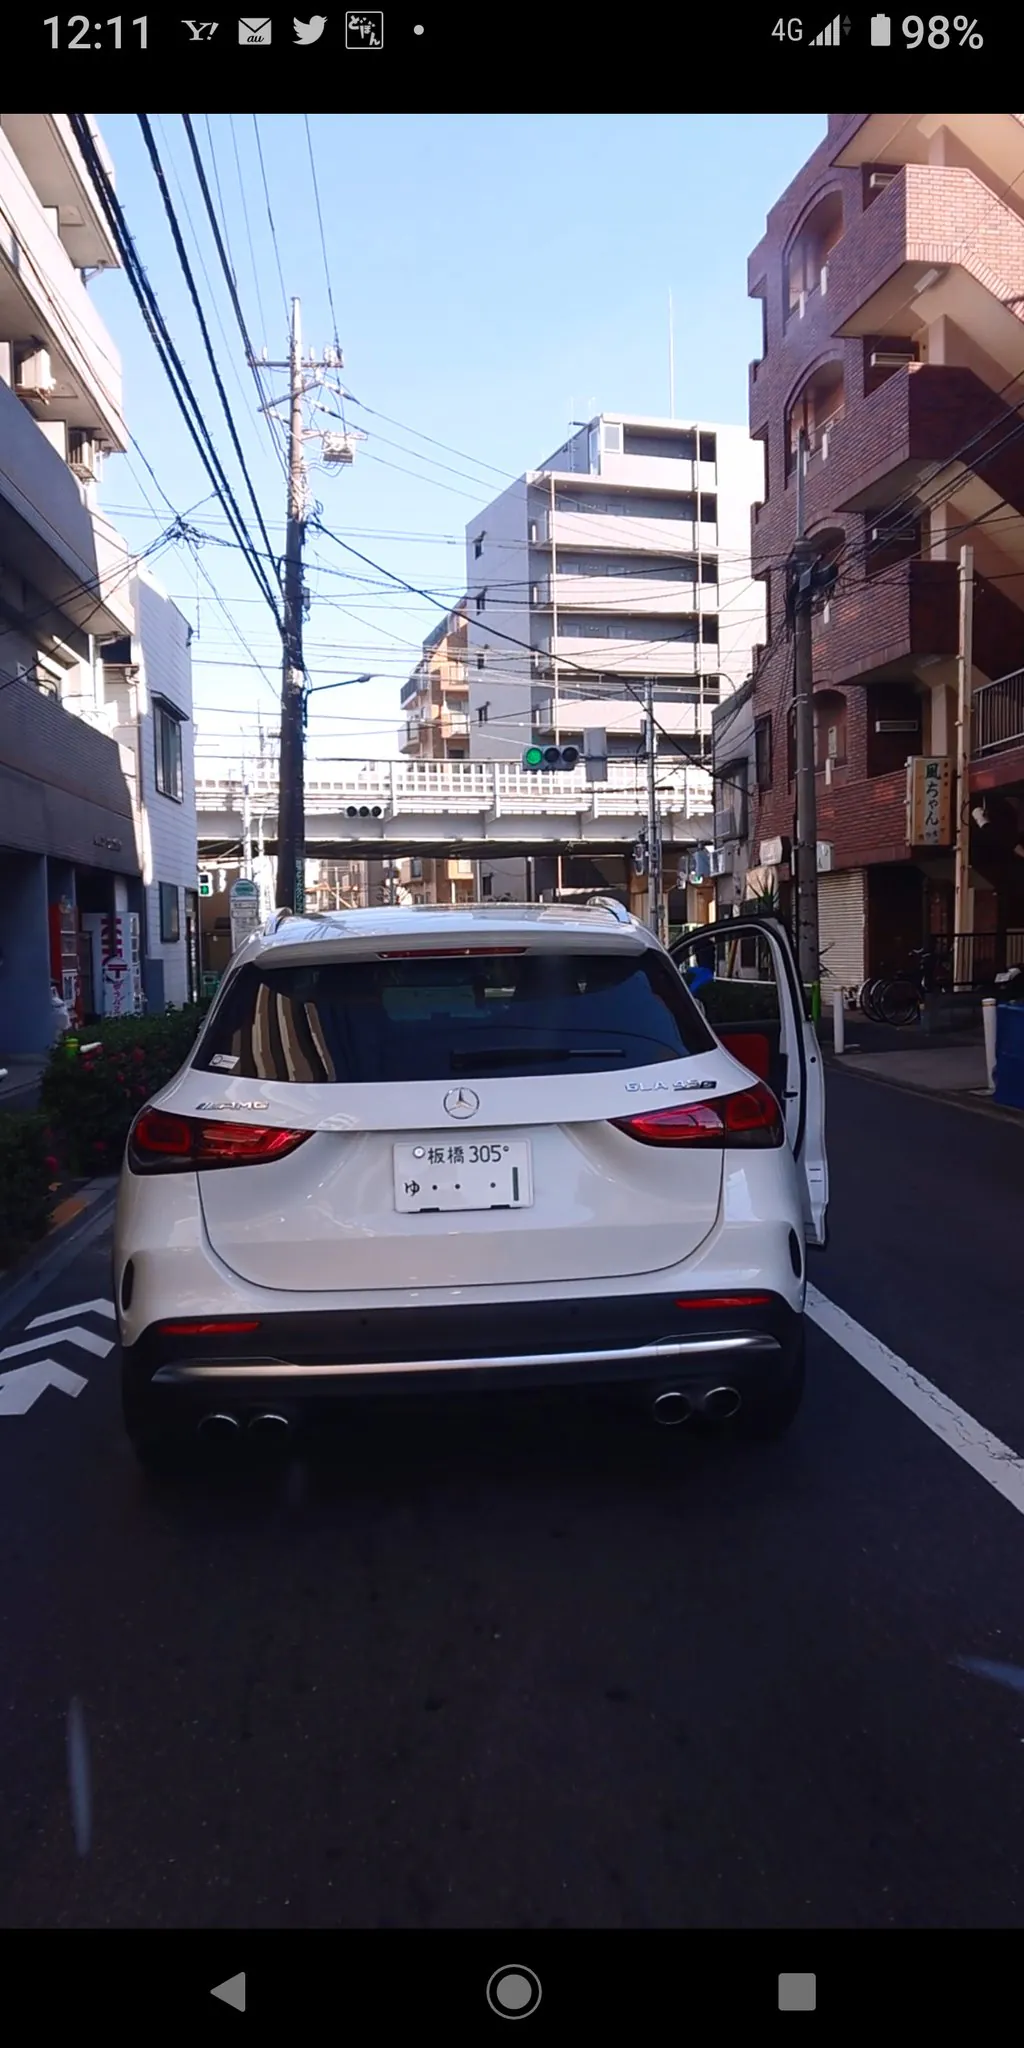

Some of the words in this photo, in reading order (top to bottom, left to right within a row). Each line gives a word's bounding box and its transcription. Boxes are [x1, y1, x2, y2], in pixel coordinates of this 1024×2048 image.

[625, 1081, 669, 1093] GLA
[427, 1146, 465, 1165] 板橋
[468, 1144, 502, 1164] 305
[404, 1179, 421, 1197] ゆ
